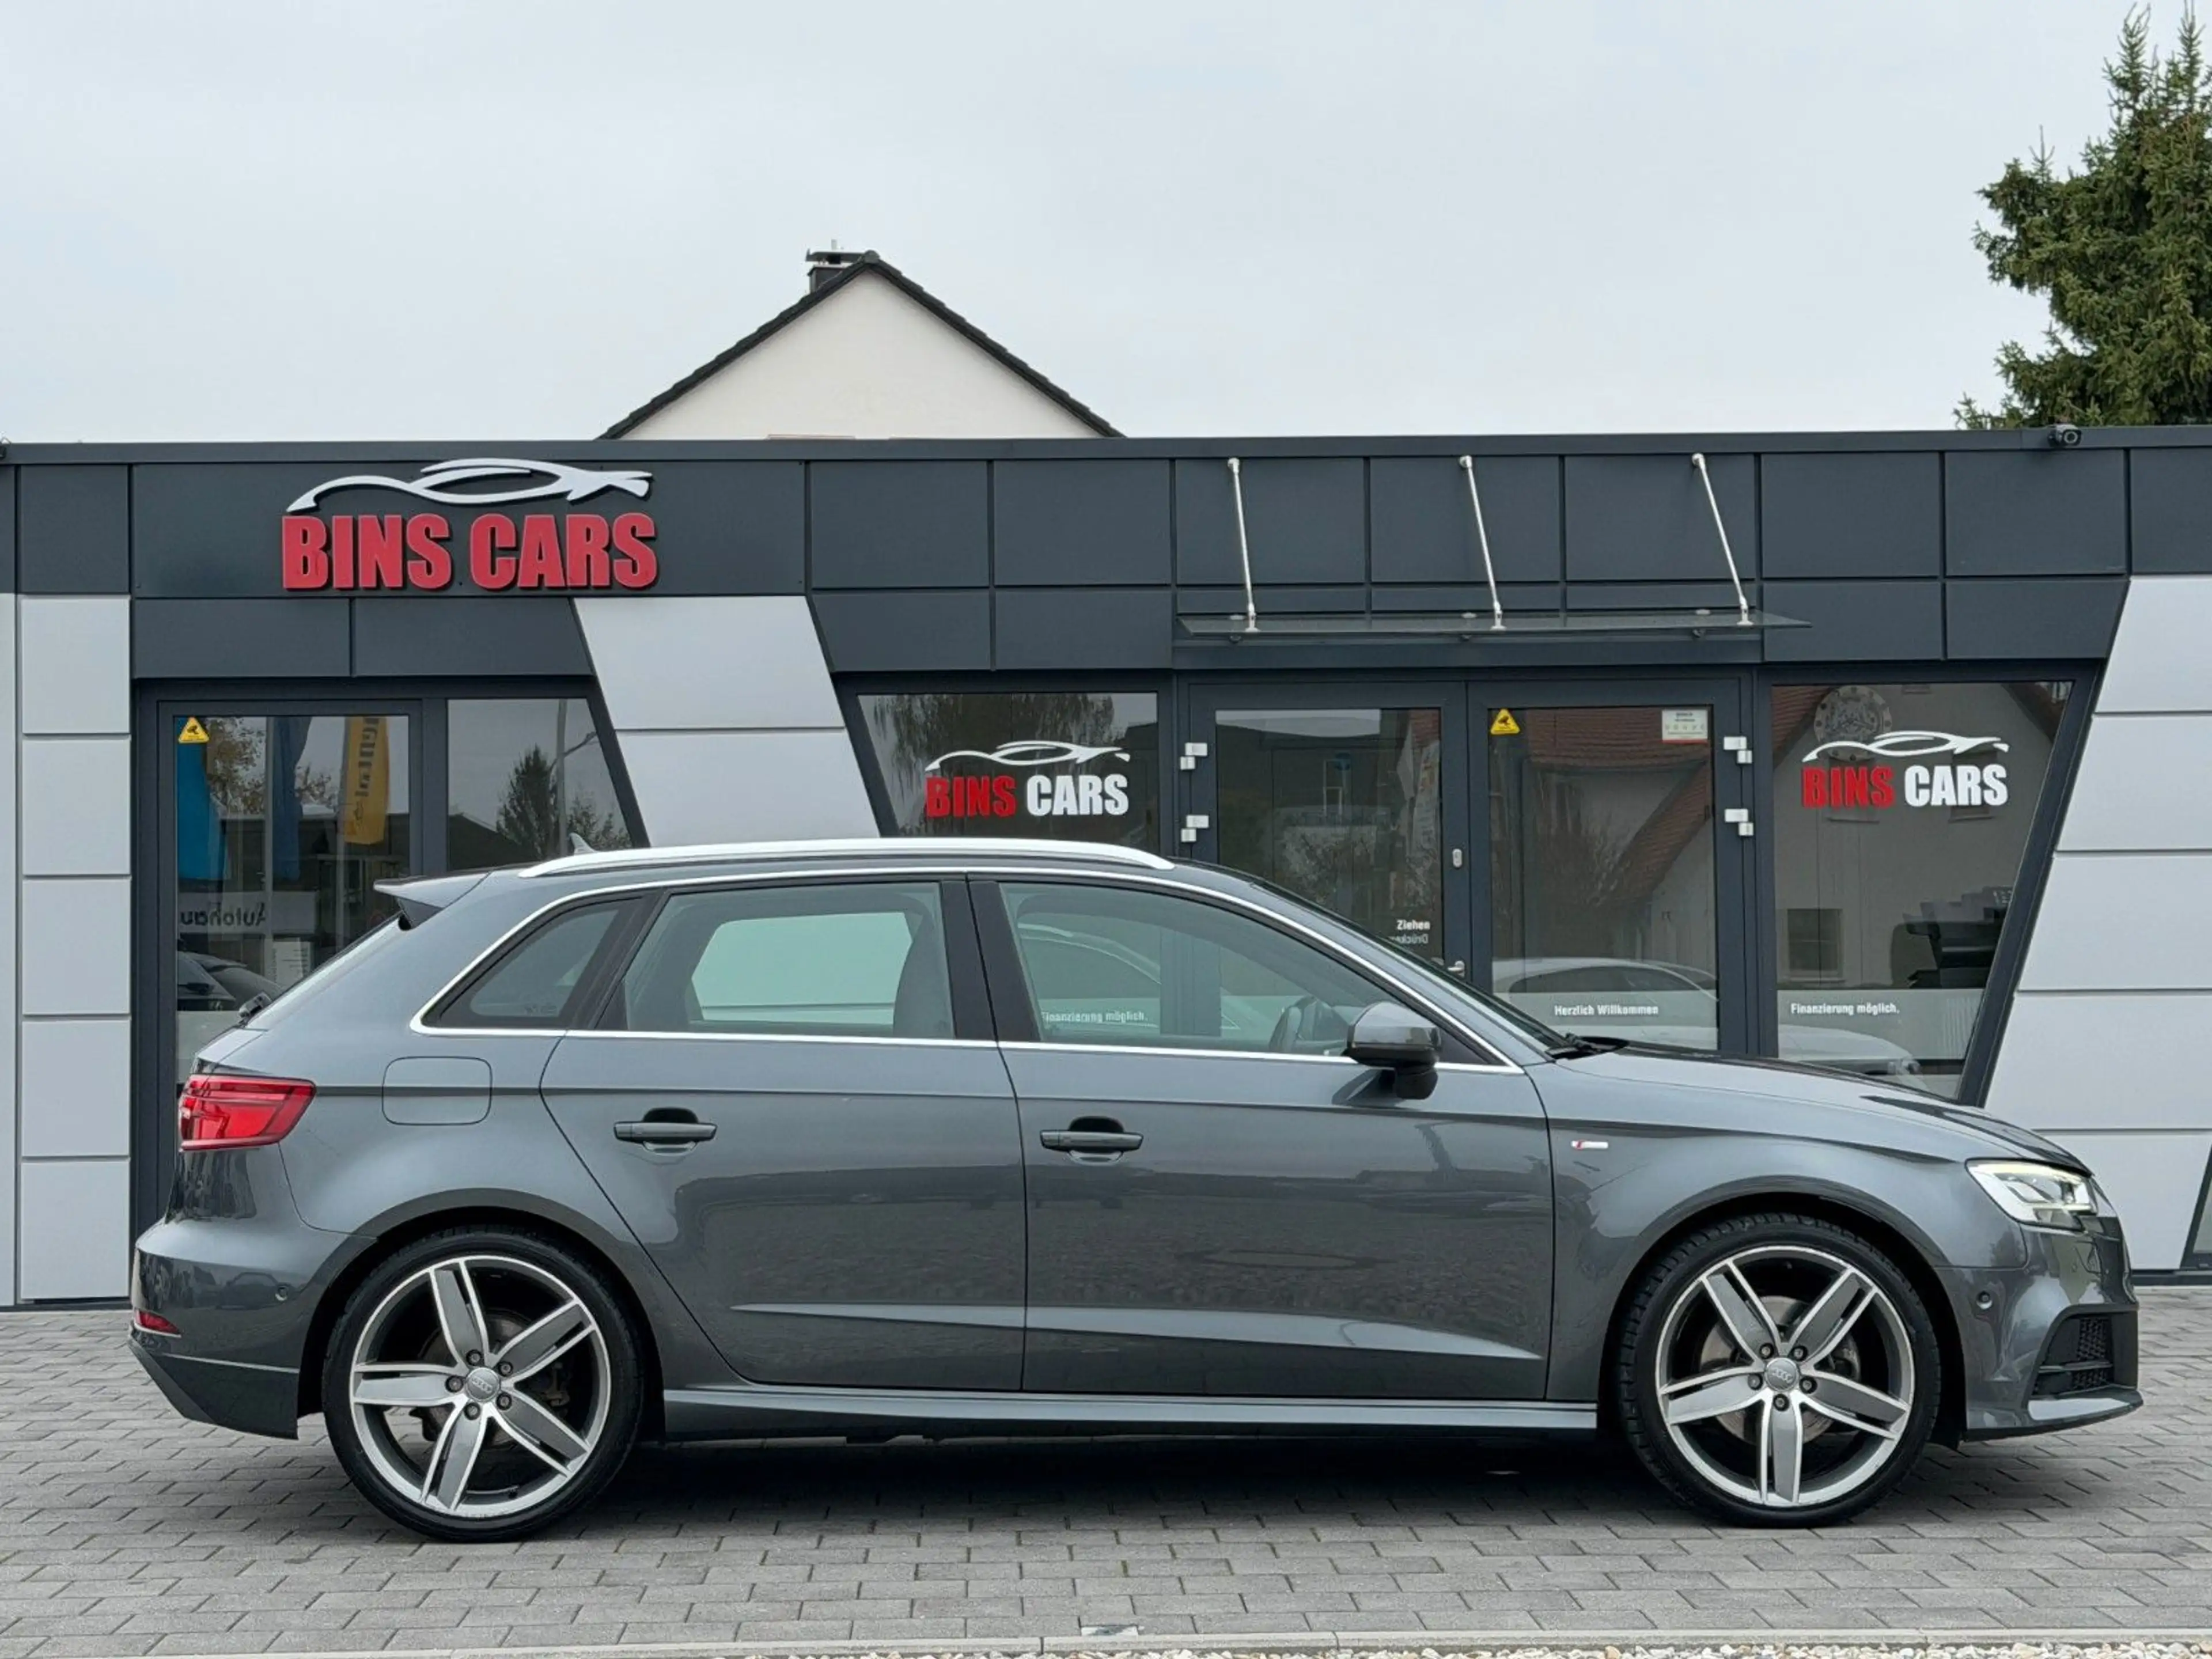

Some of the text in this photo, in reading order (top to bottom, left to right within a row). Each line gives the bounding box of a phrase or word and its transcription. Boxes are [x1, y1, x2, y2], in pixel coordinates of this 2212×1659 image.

[282, 513, 658, 590] BINS CARS
[925, 774, 1130, 818] BINS CARS
[1801, 764, 2009, 809] BINS CARS
[1397, 919, 1431, 930] Ziehen
[1554, 1004, 1659, 1016] Herzlich Willkommen
[1790, 1002, 1900, 1016] Finanzierung möglich.
